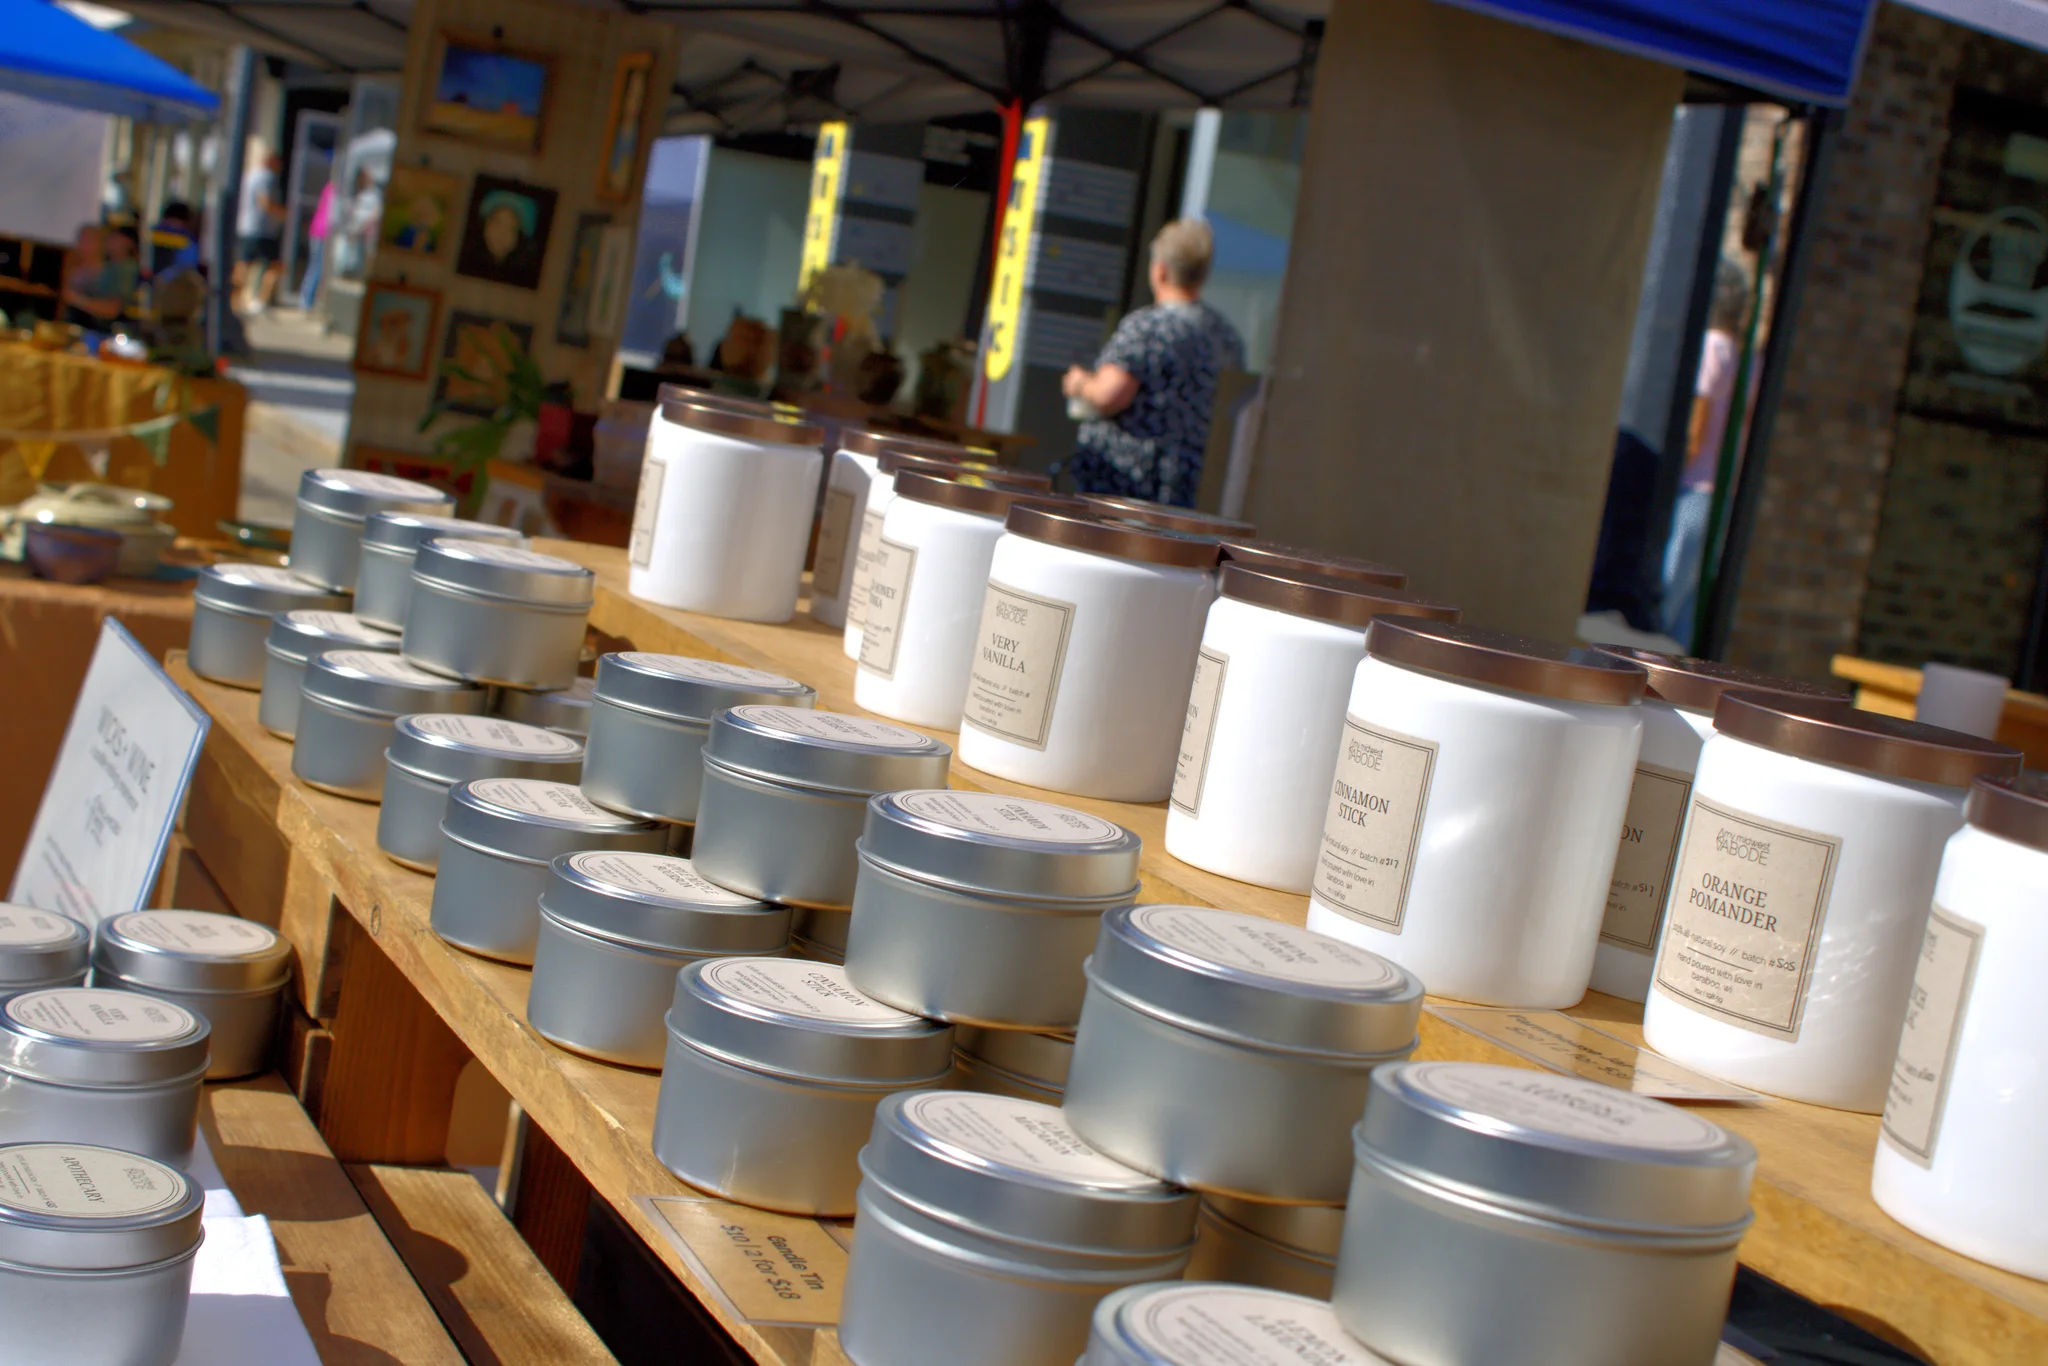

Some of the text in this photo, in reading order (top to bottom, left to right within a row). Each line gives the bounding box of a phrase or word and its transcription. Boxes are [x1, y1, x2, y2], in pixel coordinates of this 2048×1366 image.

[992, 632, 1020, 653] VERY
[983, 646, 1025, 674] VANILLA
[1349, 749, 1383, 772] ABODE
[1334, 779, 1390, 815] CINNAMON
[1006, 803, 1052, 831] CINNAMON
[1338, 802, 1368, 828] STICK
[1719, 840, 1770, 866] ABODE
[1736, 834, 1771, 852] midwest
[1360, 851, 1378, 864] batch
[1702, 872, 1768, 909] ORANGE
[1689, 887, 1777, 932] POMANDER
[1741, 951, 1767, 967] batch
[801, 979, 841, 998] STICK
[1690, 959, 1716, 975] poured
[1716, 968, 1734, 981] with
[1734, 974, 1753, 988] love
[1754, 981, 1764, 991] in
[808, 972, 870, 1007] CINNAMON
[60, 1155, 105, 1203] APOTHECARY
[720, 1225, 750, 1243] $10
[752, 1259, 778, 1276] for
[765, 1278, 801, 1300] $18
[767, 1235, 824, 1290] Candle Tin
